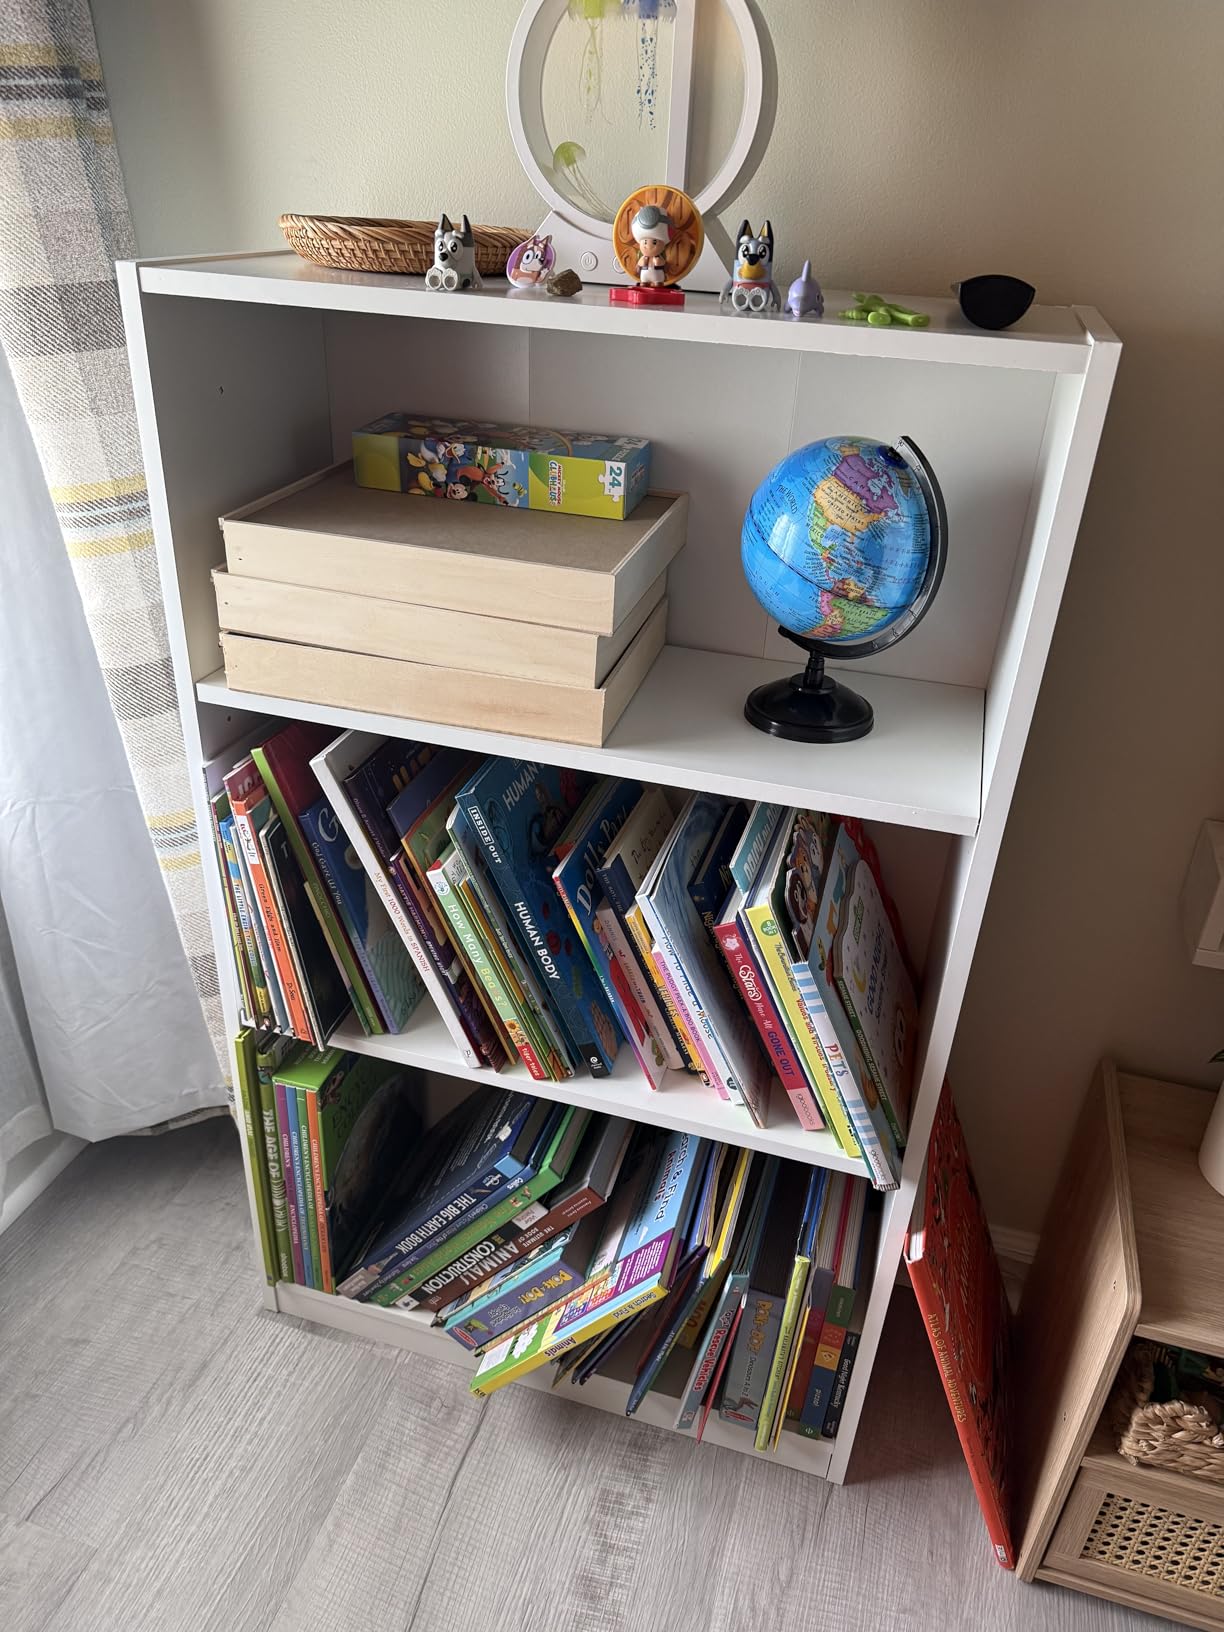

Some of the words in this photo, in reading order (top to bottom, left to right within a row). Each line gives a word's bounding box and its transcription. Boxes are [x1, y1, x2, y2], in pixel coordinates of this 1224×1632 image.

[609, 466, 622, 488] 24
[775, 484, 787, 493] THE
[784, 489, 798, 515] WORLD
[827, 499, 845, 514] UNITED
[845, 512, 865, 527] STATES
[804, 521, 825, 539] MEXICO
[502, 757, 544, 811] HUMAN
[468, 806, 493, 844] INSIDE
[487, 844, 502, 865] OUT
[258, 882, 268, 903] Green
[317, 857, 331, 877] Gave
[332, 889, 344, 904] You
[373, 871, 383, 883] My
[380, 882, 391, 897] First
[387, 897, 399, 914] 1000
[397, 914, 410, 934] Words
[410, 941, 429, 971] SPANISH
[446, 902, 466, 930] How
[460, 930, 484, 965] Many
[513, 899, 543, 947] HUMAN
[536, 946, 560, 983] BODY
[774, 942, 783, 953] The
[733, 952, 743, 964] The
[736, 963, 763, 1004] Stars
[657, 984, 679, 1019] VEHICLES
[659, 960, 668, 972] THE
[665, 972, 678, 993] PUDGY
[690, 1026, 701, 1043] BOOK
[837, 978, 849, 1000] SESAME
[845, 997, 857, 1019] STREET
[805, 1021, 814, 1034] and
[767, 1029, 783, 1056] GONE
[779, 1056, 794, 1078] OUT
[824, 1042, 849, 1078] PETS
[868, 1061, 880, 1081] SESAME
[874, 1080, 888, 1102] STREET
[262, 1108, 274, 1132] THE
[265, 1133, 277, 1159] AGE
[268, 1160, 280, 1178] OF
[655, 1150, 677, 1202] Animals
[671, 1168, 683, 1182] &
[505, 1176, 524, 1191] Collins
[439, 1202, 459, 1221] BIG
[453, 1190, 476, 1211] THE
[654, 1183, 678, 1222] Find
[289, 1203, 299, 1243] ENCYCLOPEDIA
[415, 1213, 445, 1238] EARTH
[523, 1226, 538, 1239] BOOK
[542, 1224, 554, 1234] THE
[393, 1231, 422, 1255] BOOK
[520, 1230, 544, 1248] ULTIMATE
[418, 1237, 496, 1298] CONSTRUCTION
[632, 1291, 657, 1308] Search
[612, 1306, 629, 1320] Find
[926, 1312, 940, 1338] ATLAS
[543, 1337, 577, 1357] Animals
[705, 1325, 727, 1359] Rescue
[934, 1338, 945, 1351] OF
[690, 1355, 714, 1394] Vehicles
[841, 1357, 851, 1371] Good
[937, 1349, 952, 1378] ANIMAL
[837, 1370, 847, 1384] Night
[830, 1383, 845, 1408] Kentucky
[945, 1378, 966, 1423] ADVENTURES
